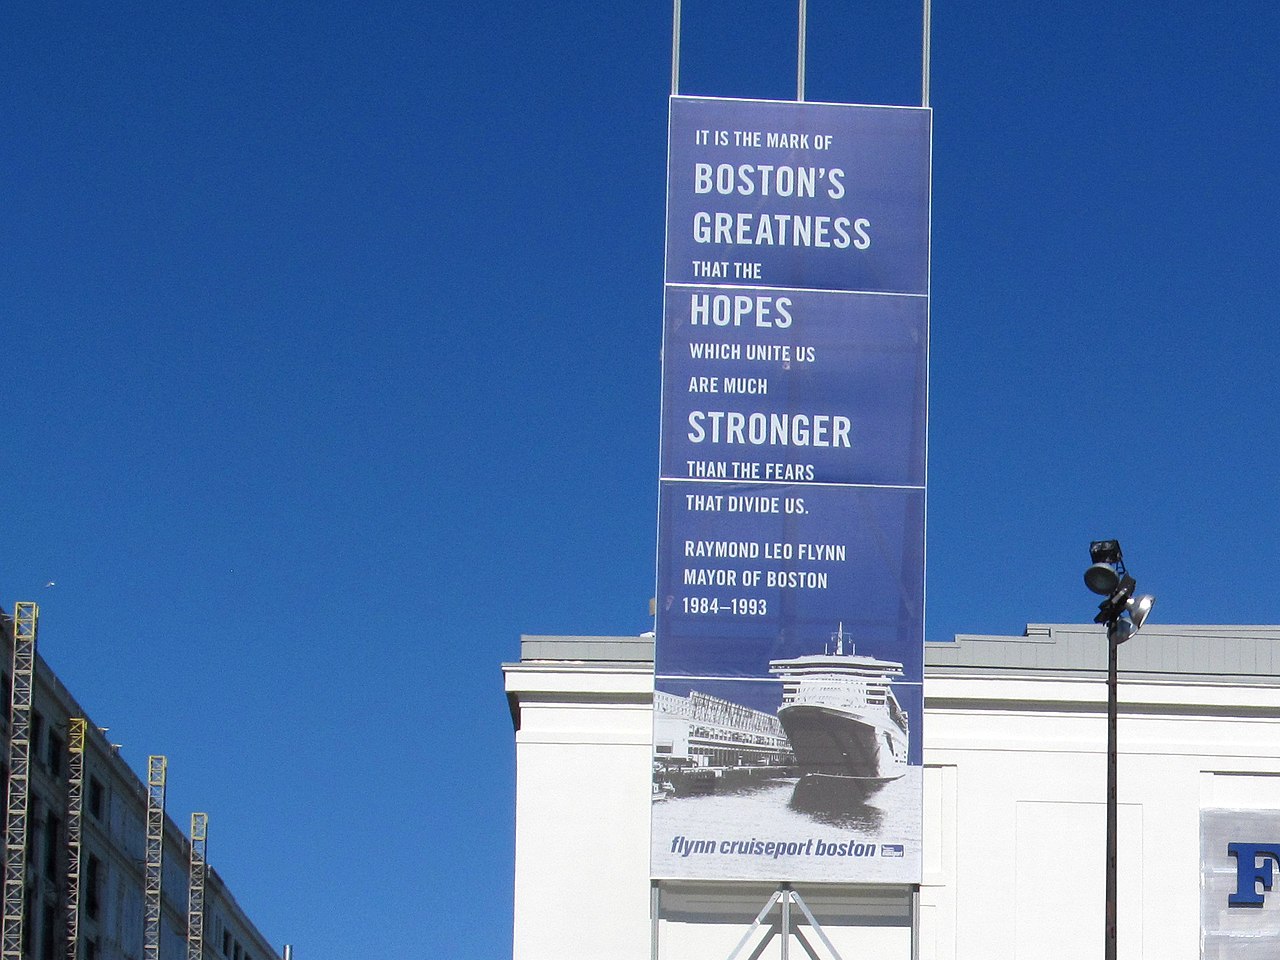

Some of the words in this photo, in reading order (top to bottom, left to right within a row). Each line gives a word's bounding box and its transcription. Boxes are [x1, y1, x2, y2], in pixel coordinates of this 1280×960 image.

[695, 130, 709, 146] IT
[714, 131, 729, 146] IS
[734, 132, 761, 148] THE
[767, 132, 809, 150] MARK
[814, 135, 832, 151] OF
[694, 163, 845, 199] BOSTON'S
[693, 212, 871, 250] GREATNESS
[692, 261, 729, 278] THAT
[734, 262, 762, 279] THE
[691, 294, 793, 328] HOPES
[689, 342, 741, 360] WHICH
[746, 344, 790, 361] UNITE
[796, 346, 815, 363] US
[689, 377, 719, 393] ARE
[724, 378, 767, 395] MUCH
[688, 411, 851, 447] STRONGER
[687, 461, 727, 478] THAN
[732, 462, 760, 479] THE
[766, 463, 815, 481] FEARS
[686, 494, 724, 512] THAT
[729, 496, 780, 513] DIVIDE
[785, 497, 809, 514] US.
[685, 541, 759, 559] RAYMOND
[764, 543, 793, 560] LEO
[798, 544, 846, 561] FLYNN
[684, 569, 737, 586] MAYOR
[742, 570, 762, 587] OF
[767, 571, 828, 589] BOSTON
[671, 836, 717, 857] flynn
[720, 837, 813, 859] cruiseport
[815, 840, 876, 858] boston
